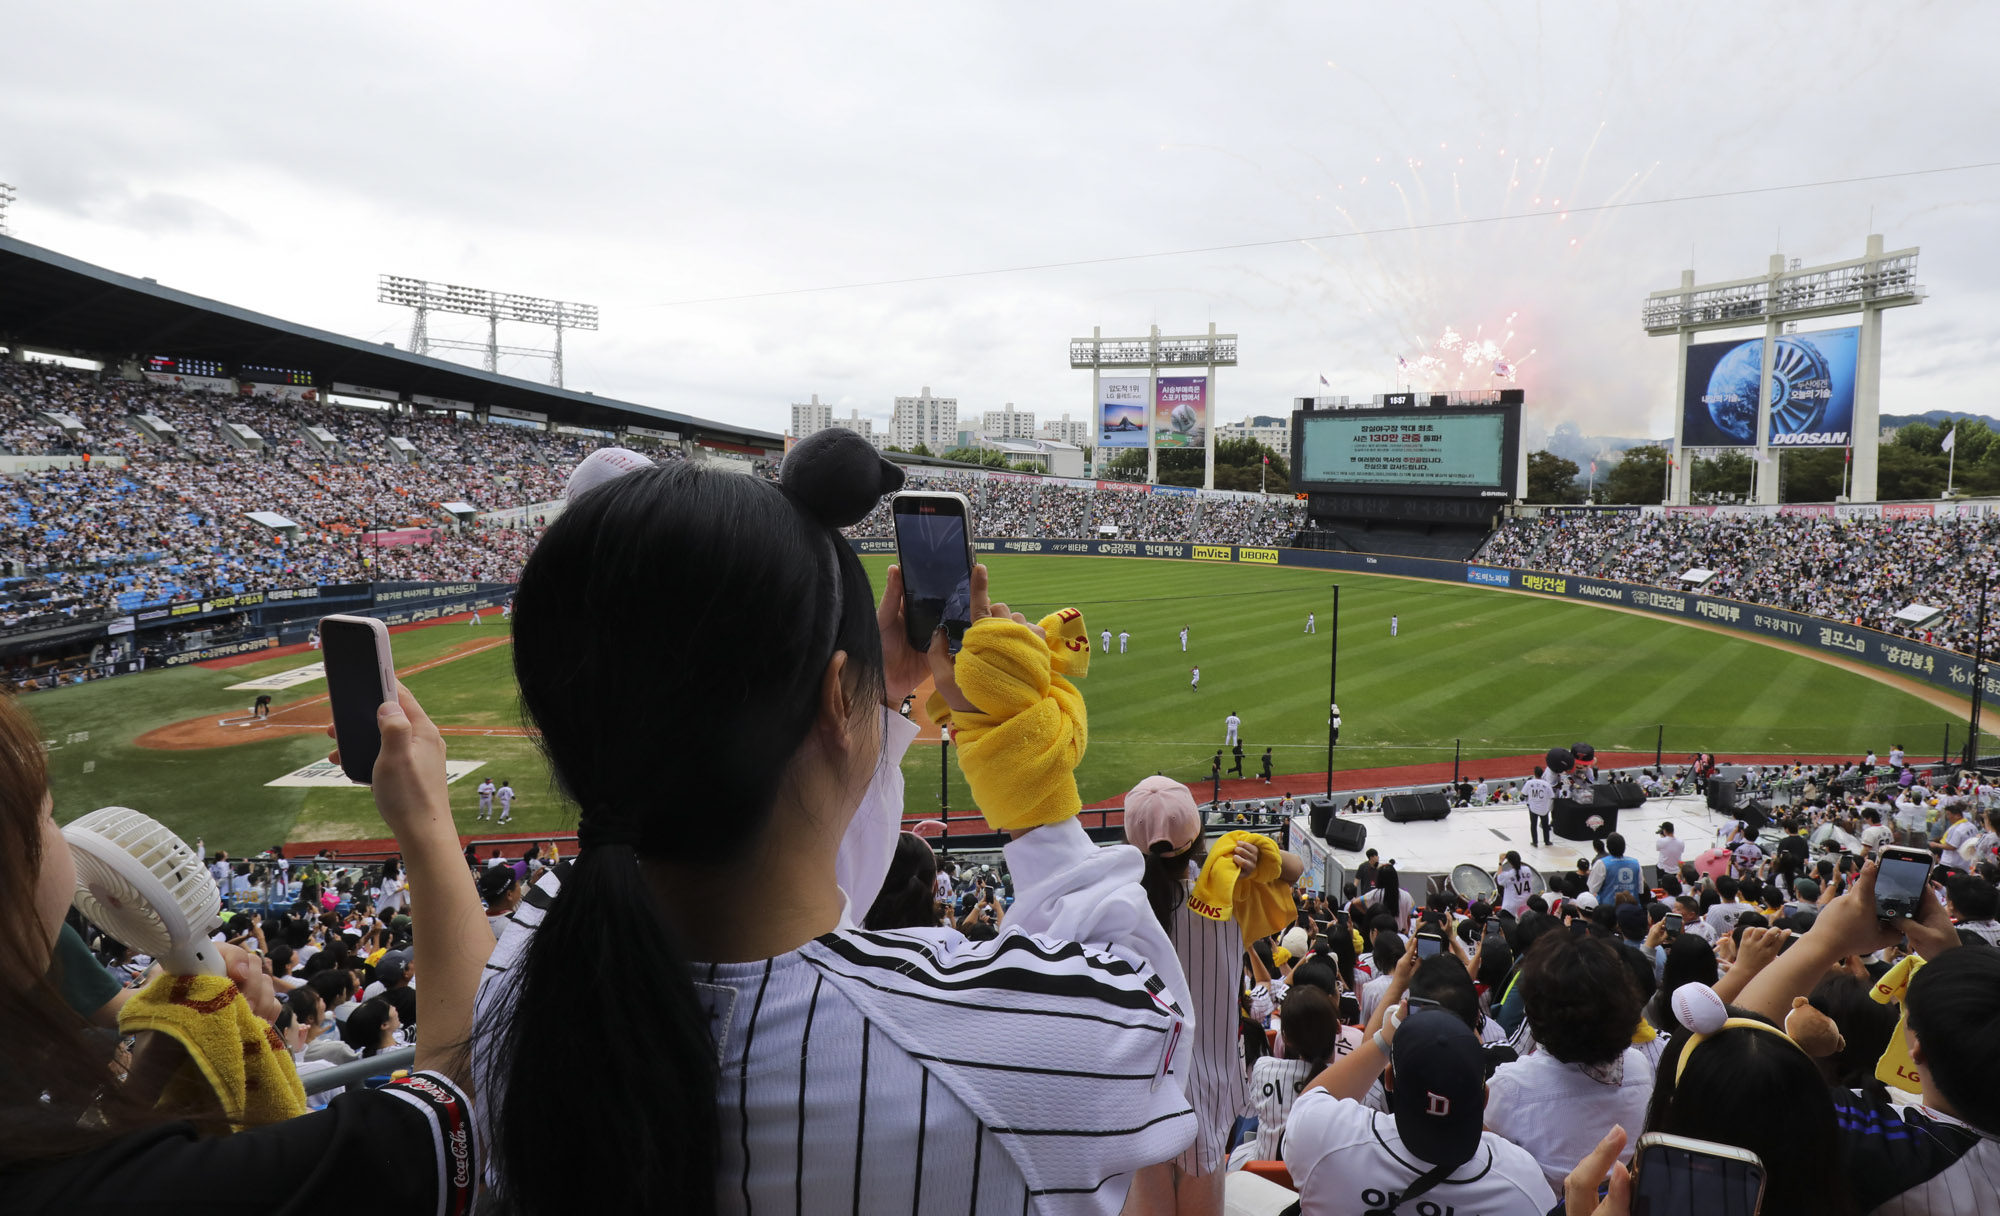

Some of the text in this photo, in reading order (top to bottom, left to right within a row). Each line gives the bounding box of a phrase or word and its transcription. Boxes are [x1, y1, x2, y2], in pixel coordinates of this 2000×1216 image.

[1369, 434, 1398, 442] 130만
[1773, 432, 1847, 444] DOOSAN
[869, 541, 897, 549] 유안타증
[1110, 543, 1136, 554] 금강주택
[1145, 544, 1183, 557] 현대해상
[1240, 550, 1277, 561] UBORA
[1475, 572, 1509, 585] 도미노피자
[1522, 575, 1566, 594] 대방건설
[1579, 584, 1622, 600] HANCOM
[1649, 592, 1685, 612] 대보건설
[1695, 600, 1740, 622] 치킨마루
[1754, 614, 1803, 636] 한국경제TV
[1532, 789, 1544, 798] MC
[1299, 876, 1314, 889] 06
[1514, 880, 1531, 896] V4
[234, 890, 258, 904] 108
[1189, 895, 1222, 918] WINS
[1876, 983, 1893, 995] G
[1896, 1065, 1921, 1083] LG
[1426, 1091, 1449, 1116] D
